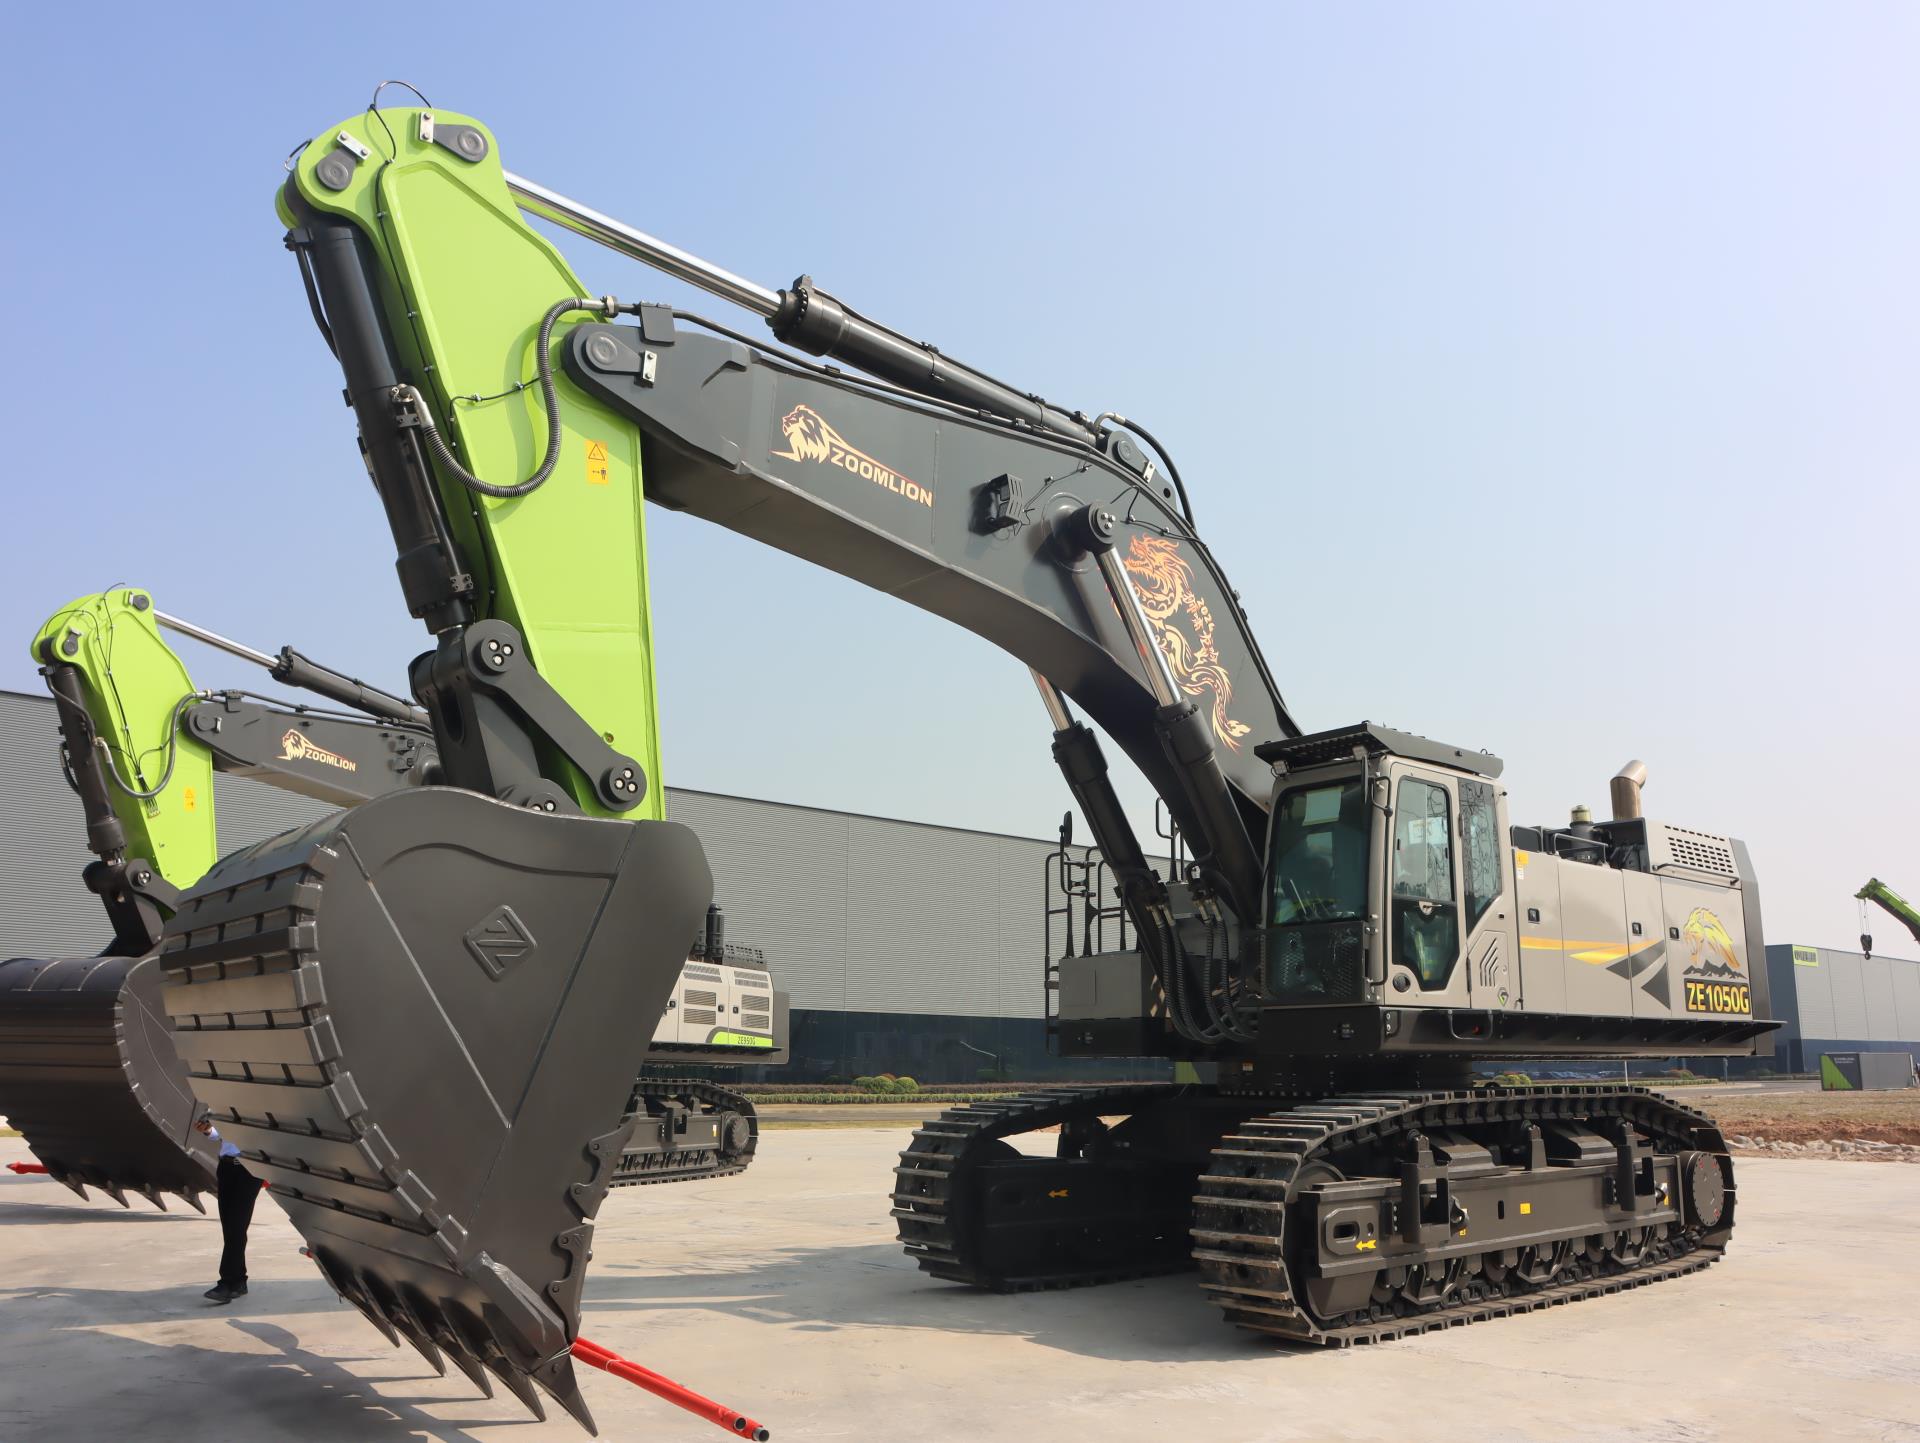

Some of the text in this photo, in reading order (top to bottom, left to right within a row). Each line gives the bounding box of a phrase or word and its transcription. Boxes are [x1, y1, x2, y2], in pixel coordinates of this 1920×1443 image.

[830, 446, 933, 508] ZOOMLION
[305, 748, 356, 772] ZOOMLION
[1686, 982, 1750, 1013] ZE1050G
